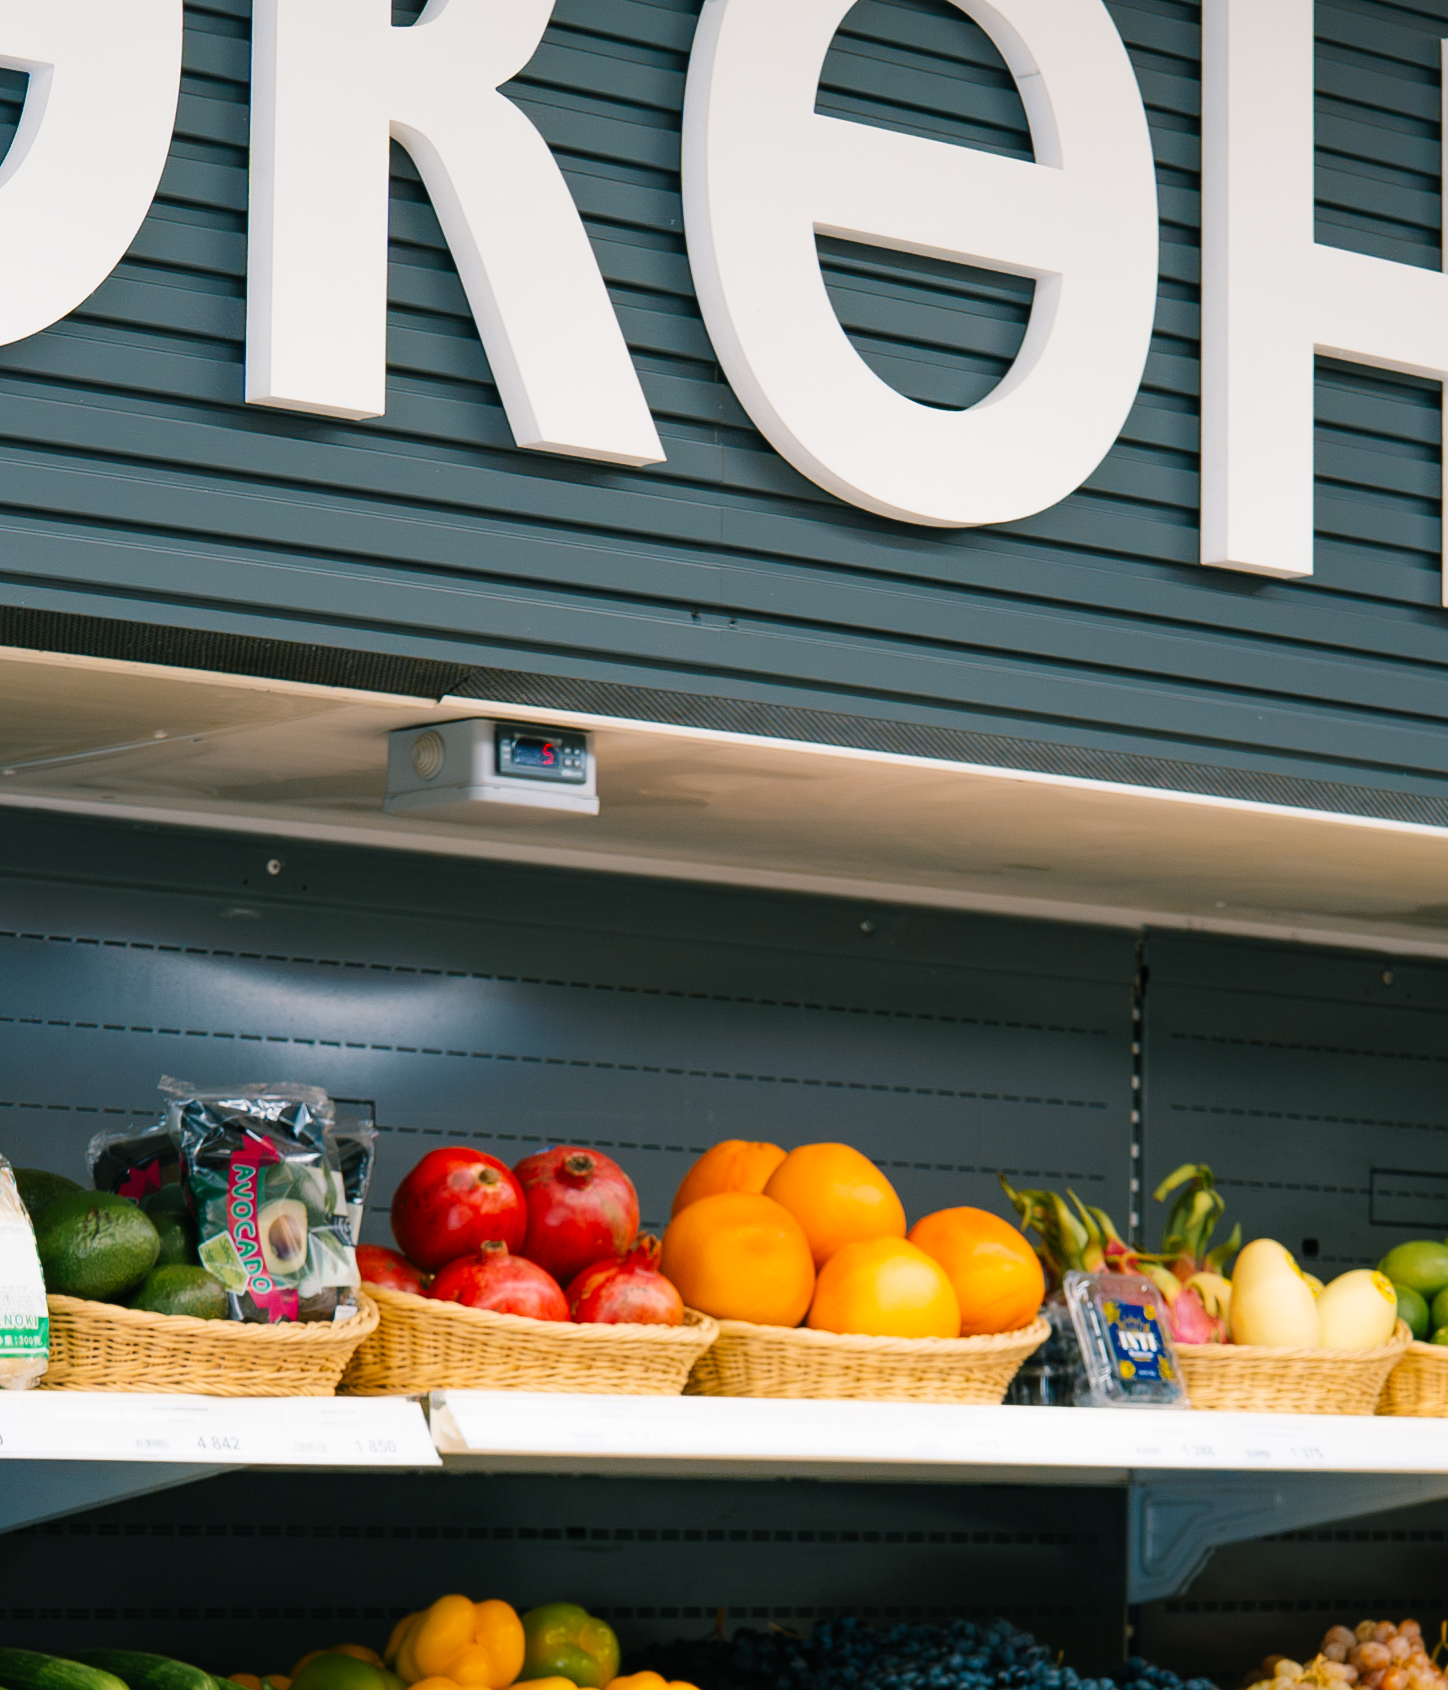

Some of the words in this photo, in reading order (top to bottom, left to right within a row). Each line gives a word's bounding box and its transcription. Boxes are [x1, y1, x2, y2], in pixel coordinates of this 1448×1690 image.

[232, 1163, 273, 1294] AVOCADO
[211, 1436, 241, 1451] 842
[366, 1439, 397, 1453] 850
